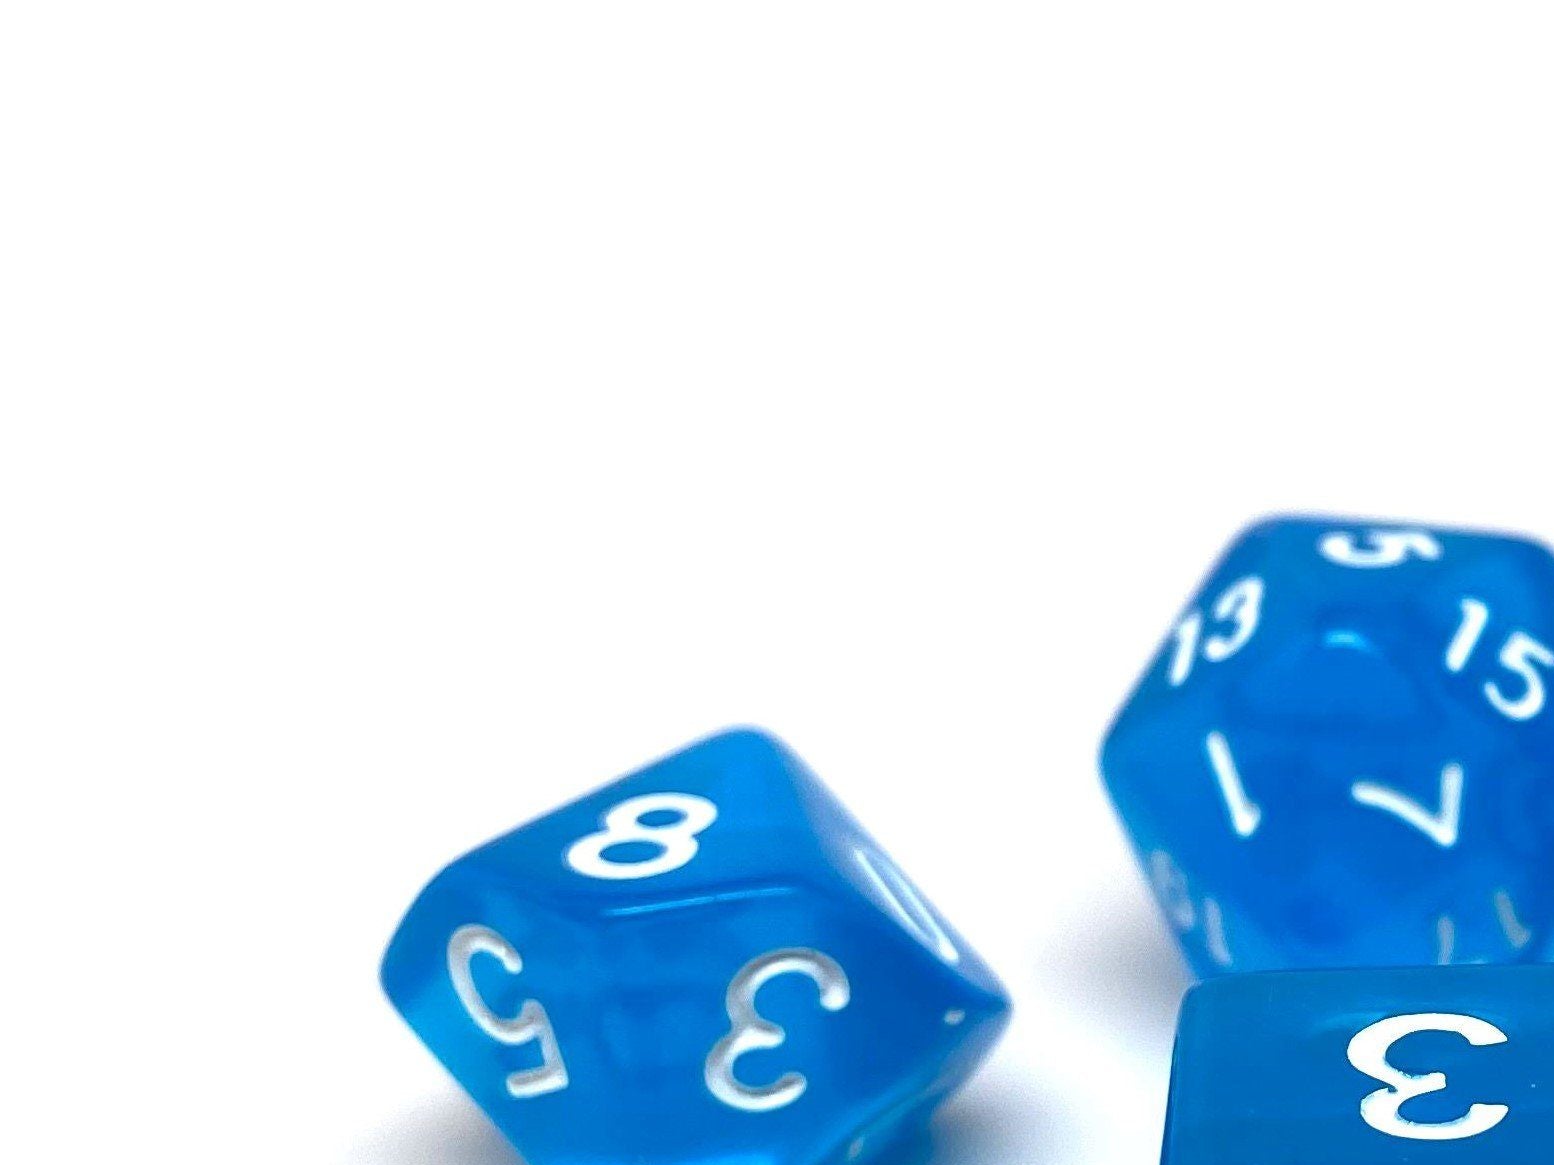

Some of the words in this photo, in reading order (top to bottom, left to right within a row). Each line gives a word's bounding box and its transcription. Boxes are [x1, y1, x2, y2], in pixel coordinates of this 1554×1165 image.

[1318, 530, 1442, 568] 5
[1168, 575, 1265, 686] 13
[564, 790, 718, 880] 8
[1206, 730, 1262, 838] 1
[1351, 763, 1464, 849] 7
[446, 923, 568, 1098] 5
[704, 946, 851, 1113] 3
[1346, 1012, 1508, 1140] 3
